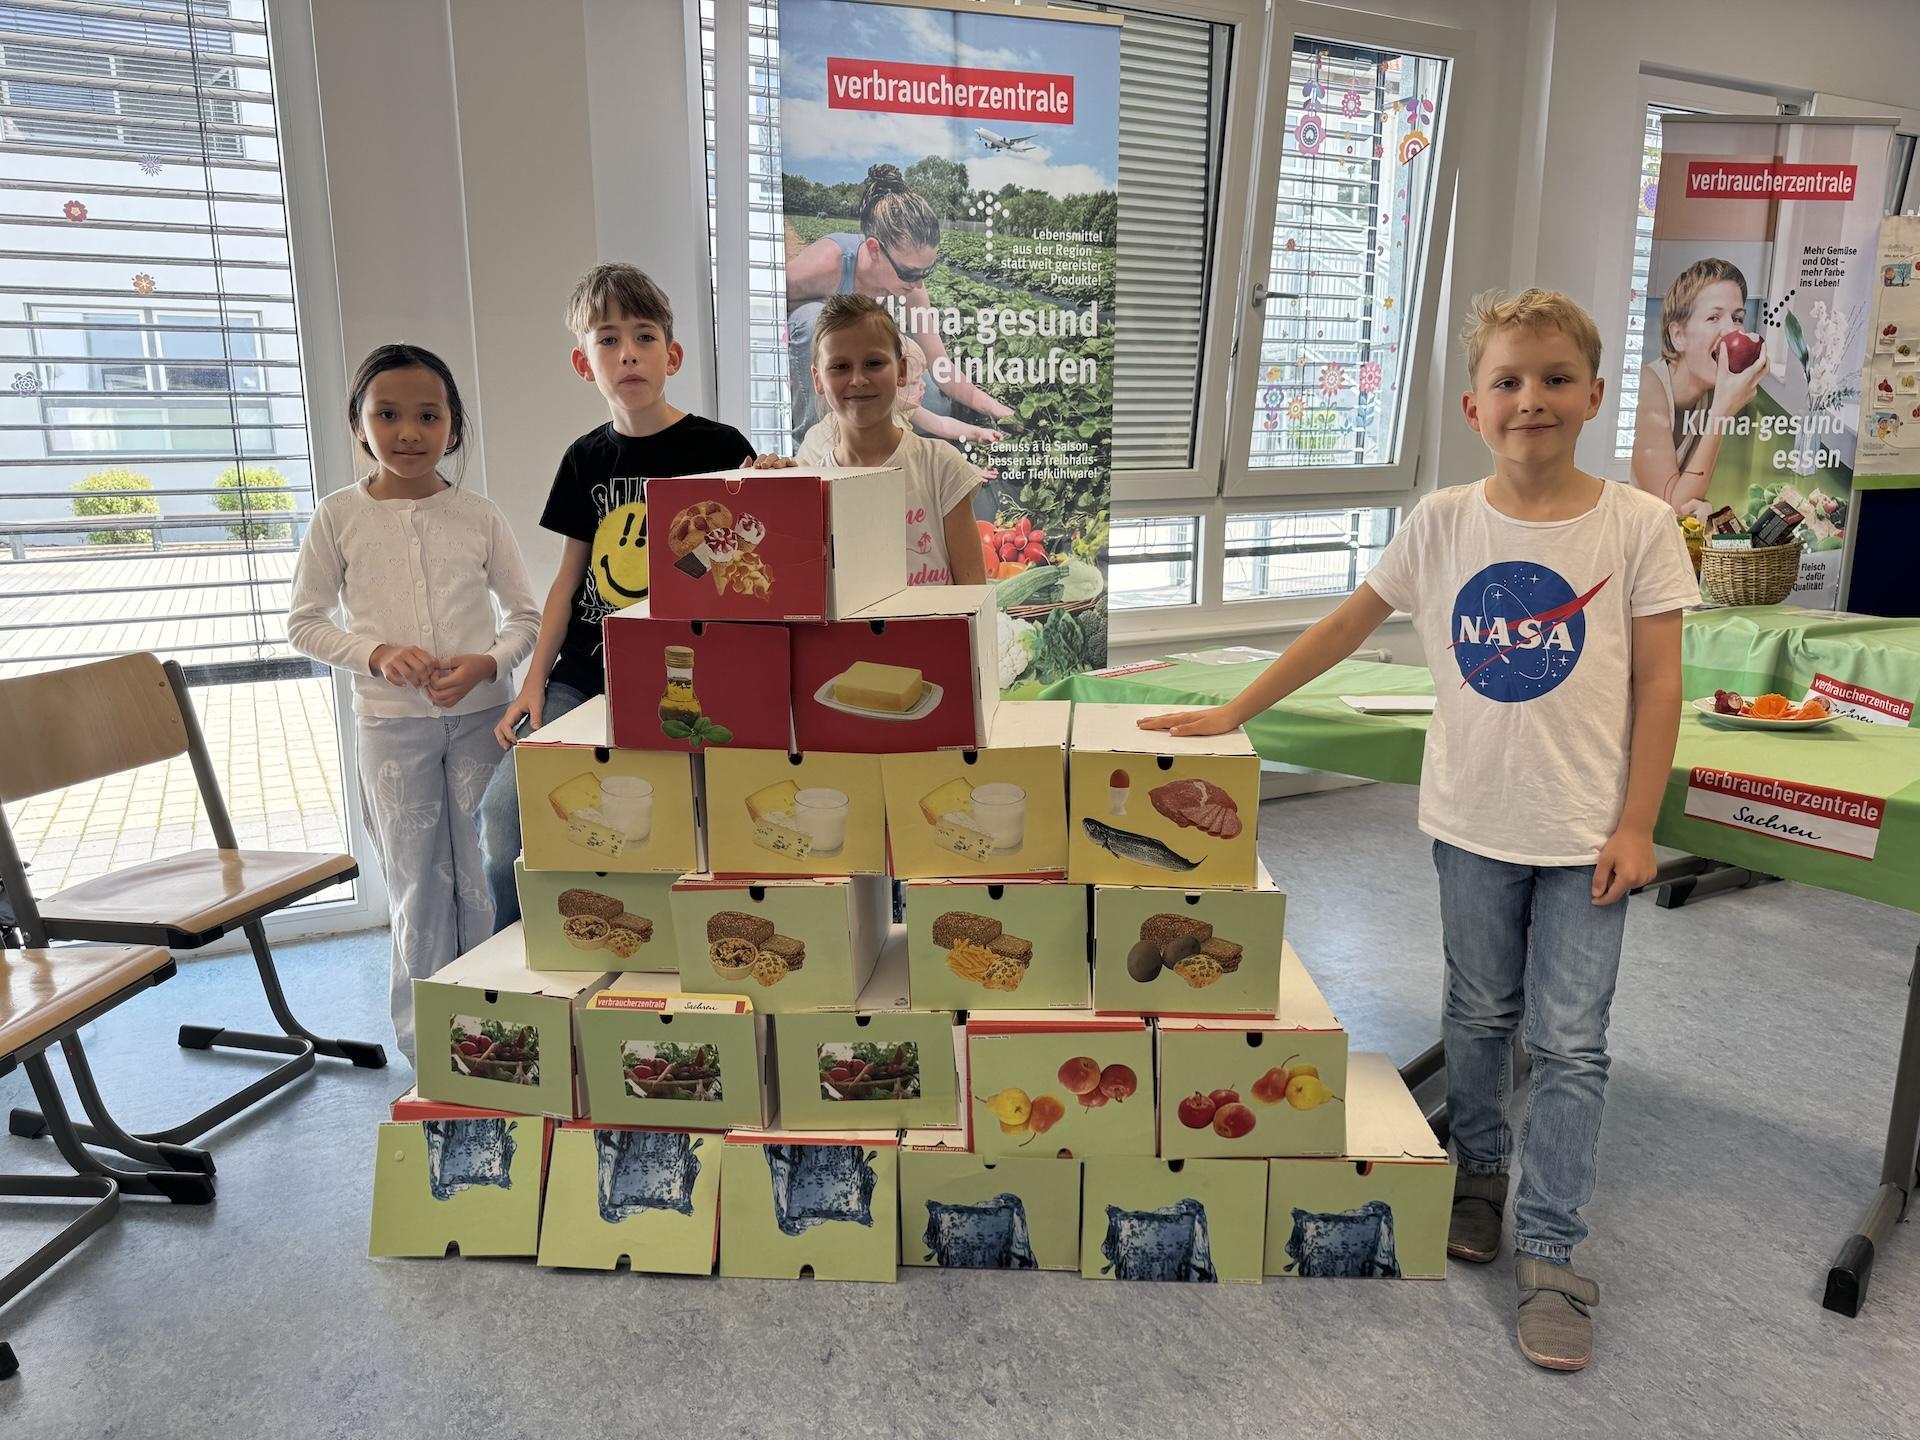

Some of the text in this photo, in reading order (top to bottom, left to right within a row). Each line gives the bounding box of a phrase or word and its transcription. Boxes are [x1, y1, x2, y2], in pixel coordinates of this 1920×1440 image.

[833, 69, 1069, 114] verbraucherzentrale
[1691, 168, 1852, 193] verbraucherzentrale
[1033, 228, 1103, 242] Lebensmittel
[1012, 245, 1032, 255] aus
[1035, 243, 1053, 255] der
[1056, 244, 1092, 258] Region
[1803, 246, 1857, 256] Mehr Gemüse
[1000, 258, 1102, 273] statt weit gereister
[1802, 257, 1818, 266] und
[1820, 257, 1839, 266] Obst
[1801, 267, 1845, 277] mehr Farbe
[1051, 273, 1101, 286] Produkte!
[1800, 278, 1840, 287] ins Leben!
[876, 295, 1098, 344] lima-gesund
[932, 347, 1096, 384] einkaufen
[1682, 409, 1845, 441] Klima-gesund
[991, 441, 1030, 452] Genuss
[1041, 441, 1051, 452] la
[1054, 440, 1088, 452] Saison
[988, 454, 1098, 466] besser als Treibhaus-
[1772, 448, 1841, 470] essen
[1001, 467, 1098, 480] oder Tiefkühlware!
[1801, 562, 1826, 571] Fleisch
[1806, 571, 1825, 581] dafür
[1459, 615, 1575, 652] NASA
[1814, 678, 1910, 717] verbraucherzentrale
[1695, 768, 1879, 822] verbraucherzentrale
[1733, 806, 1822, 840] Sachsen
[597, 995, 666, 1009] verbraucherzentrale
